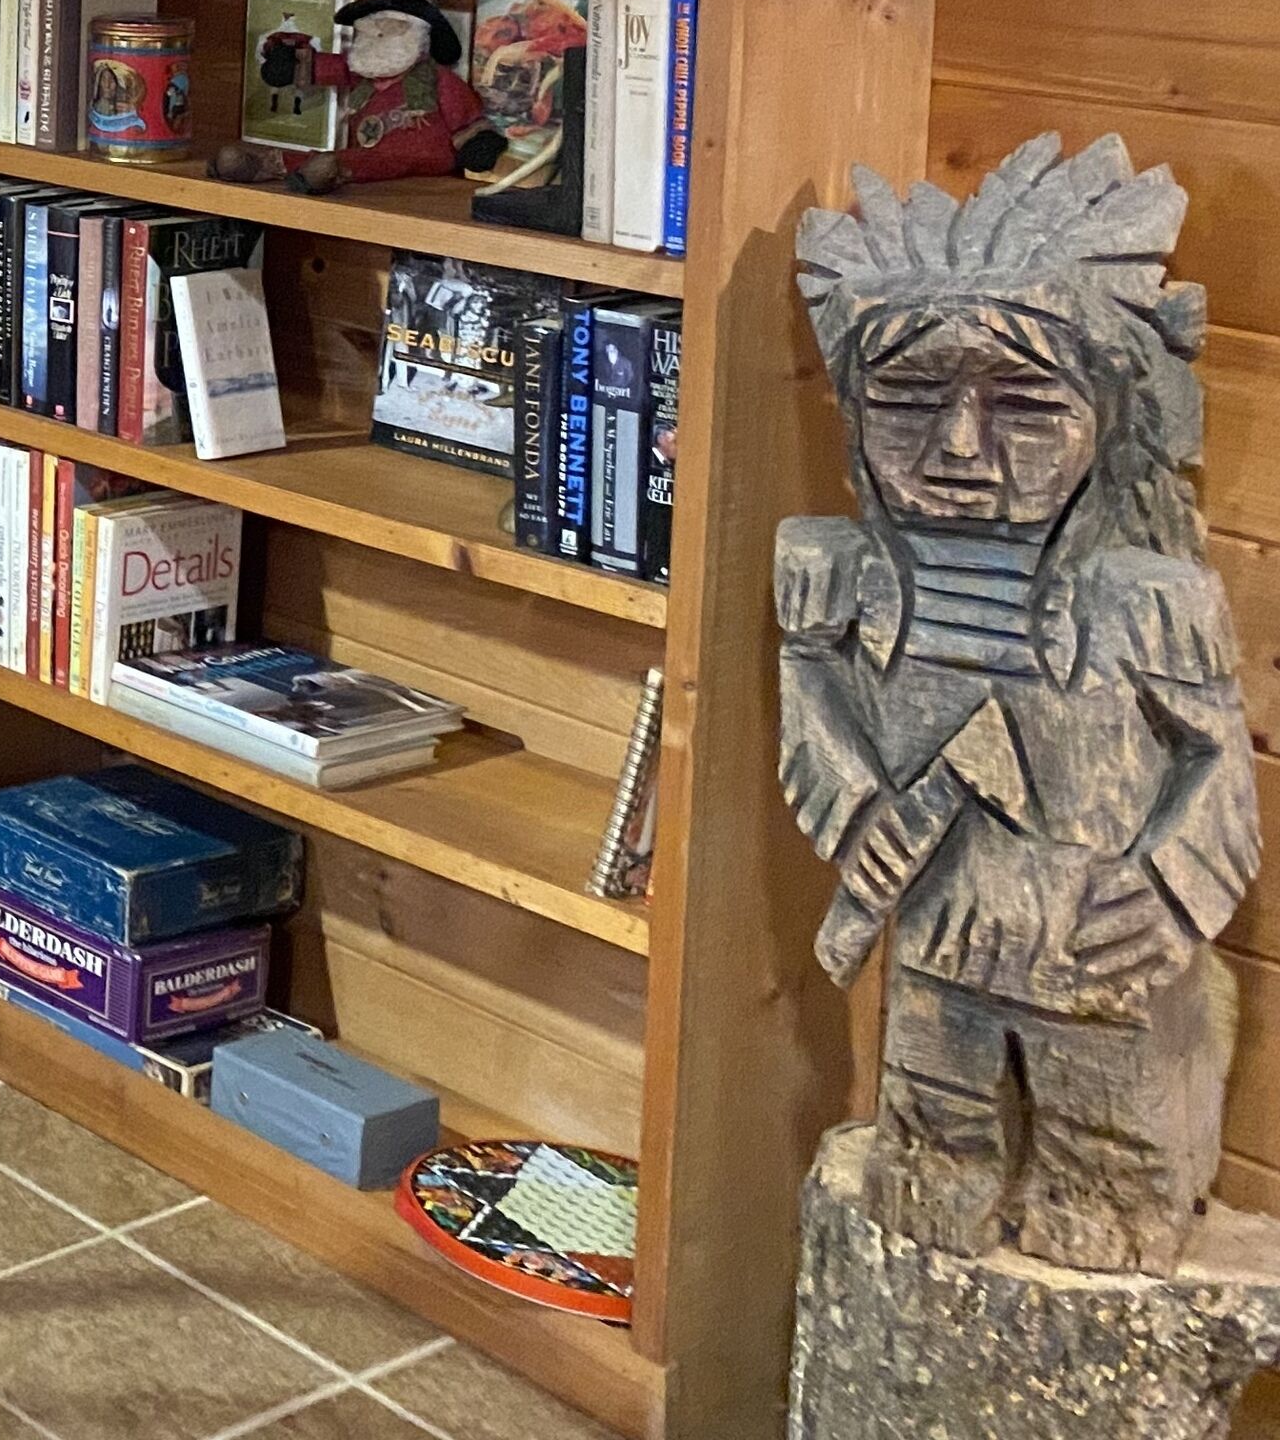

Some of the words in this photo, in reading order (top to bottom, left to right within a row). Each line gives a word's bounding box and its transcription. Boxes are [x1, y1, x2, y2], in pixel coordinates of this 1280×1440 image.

[25, 210, 38, 272] SARAH
[173, 231, 244, 270] RHETT
[128, 245, 145, 293] RHETT
[24, 275, 37, 324] PALIN
[102, 336, 113, 370] CRAIG
[128, 297, 144, 363] BUTLER'S
[571, 309, 591, 385] TONY
[26, 359, 37, 388] Rogue
[523, 336, 542, 393] JANE
[101, 371, 113, 416] HOLDEN
[126, 366, 143, 421] PEOPLE
[594, 379, 631, 400] bogart
[523, 399, 541, 480] FONDA
[559, 413, 567, 439] THE
[394, 432, 428, 448] LAURA
[432, 443, 511, 468] HILLENBRAND
[559, 443, 567, 480] GOOD
[565, 394, 588, 526] BENNETT
[523, 503, 542, 513] LIFE
[557, 485, 566, 518] LIFE
[57, 529, 69, 559] Quick
[122, 533, 234, 596] Details
[11, 540, 23, 616] DECORATING
[56, 561, 69, 618] Decorating
[73, 579, 83, 658] COTTAGES
[204, 647, 286, 666] Country
[154, 956, 256, 996] BALDERDASH
